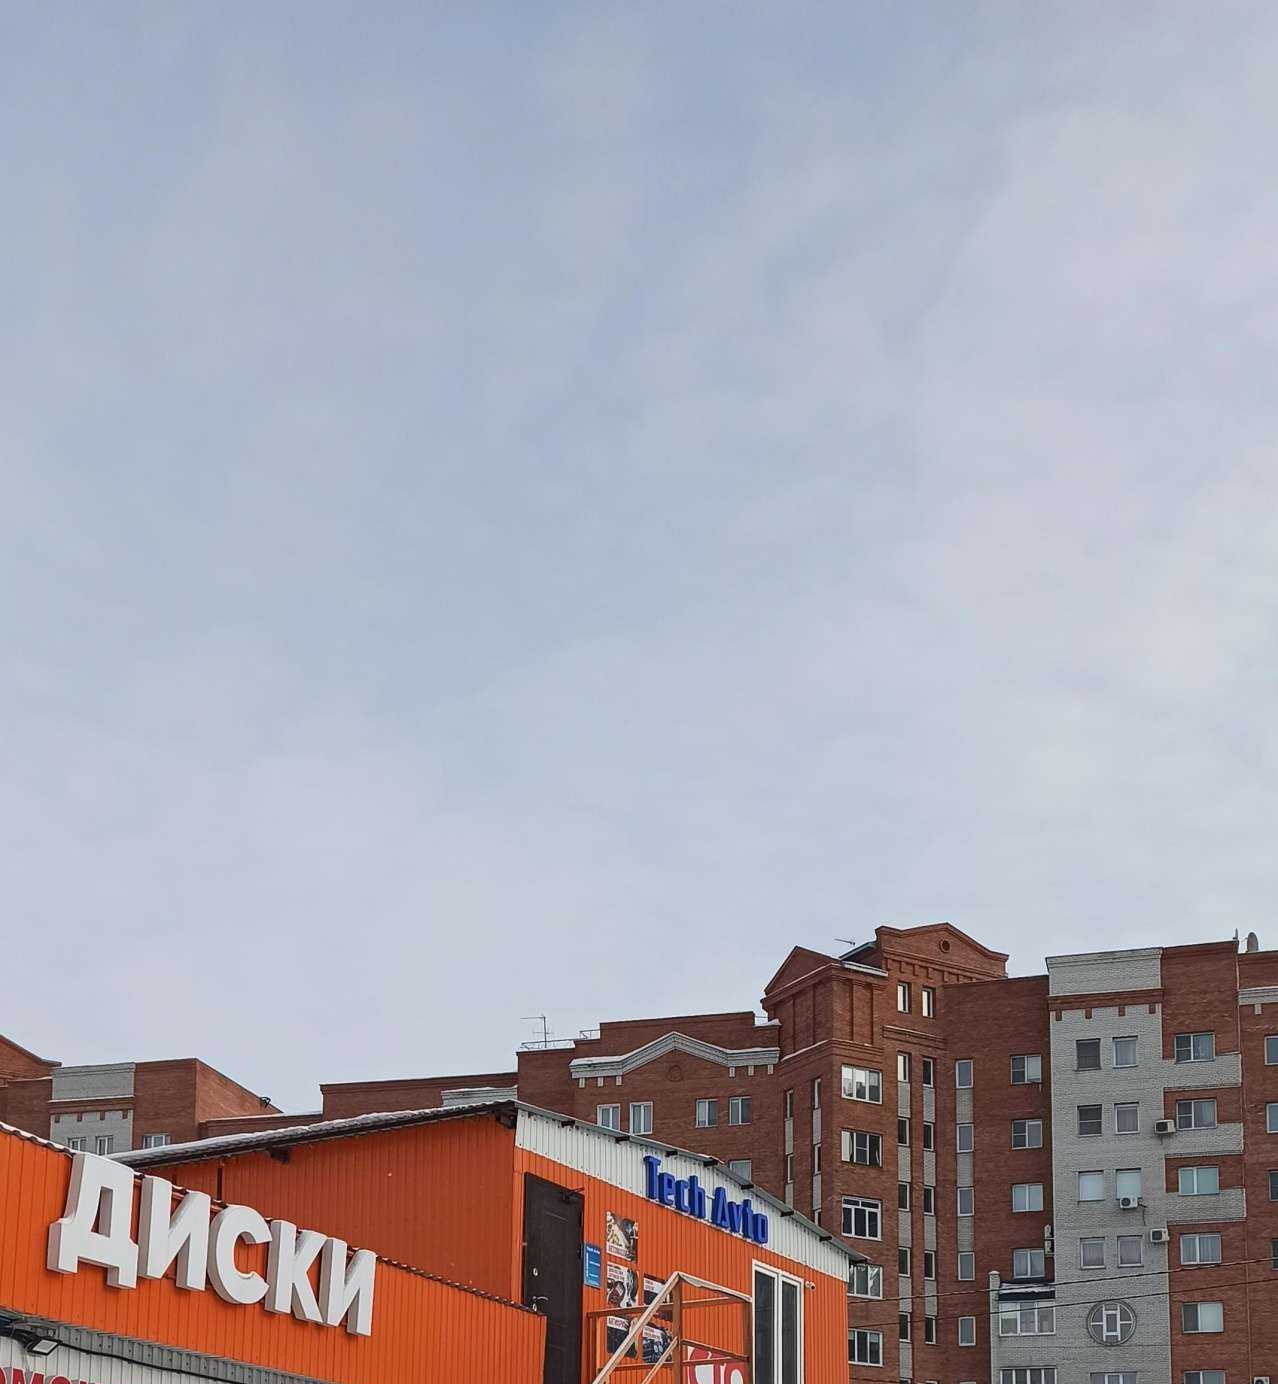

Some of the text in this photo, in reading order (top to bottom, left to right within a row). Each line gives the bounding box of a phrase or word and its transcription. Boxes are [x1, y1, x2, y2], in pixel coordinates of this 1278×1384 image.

[47, 1152, 376, 1337] ДИСКИ
[643, 1155, 769, 1244] Tech Avto
